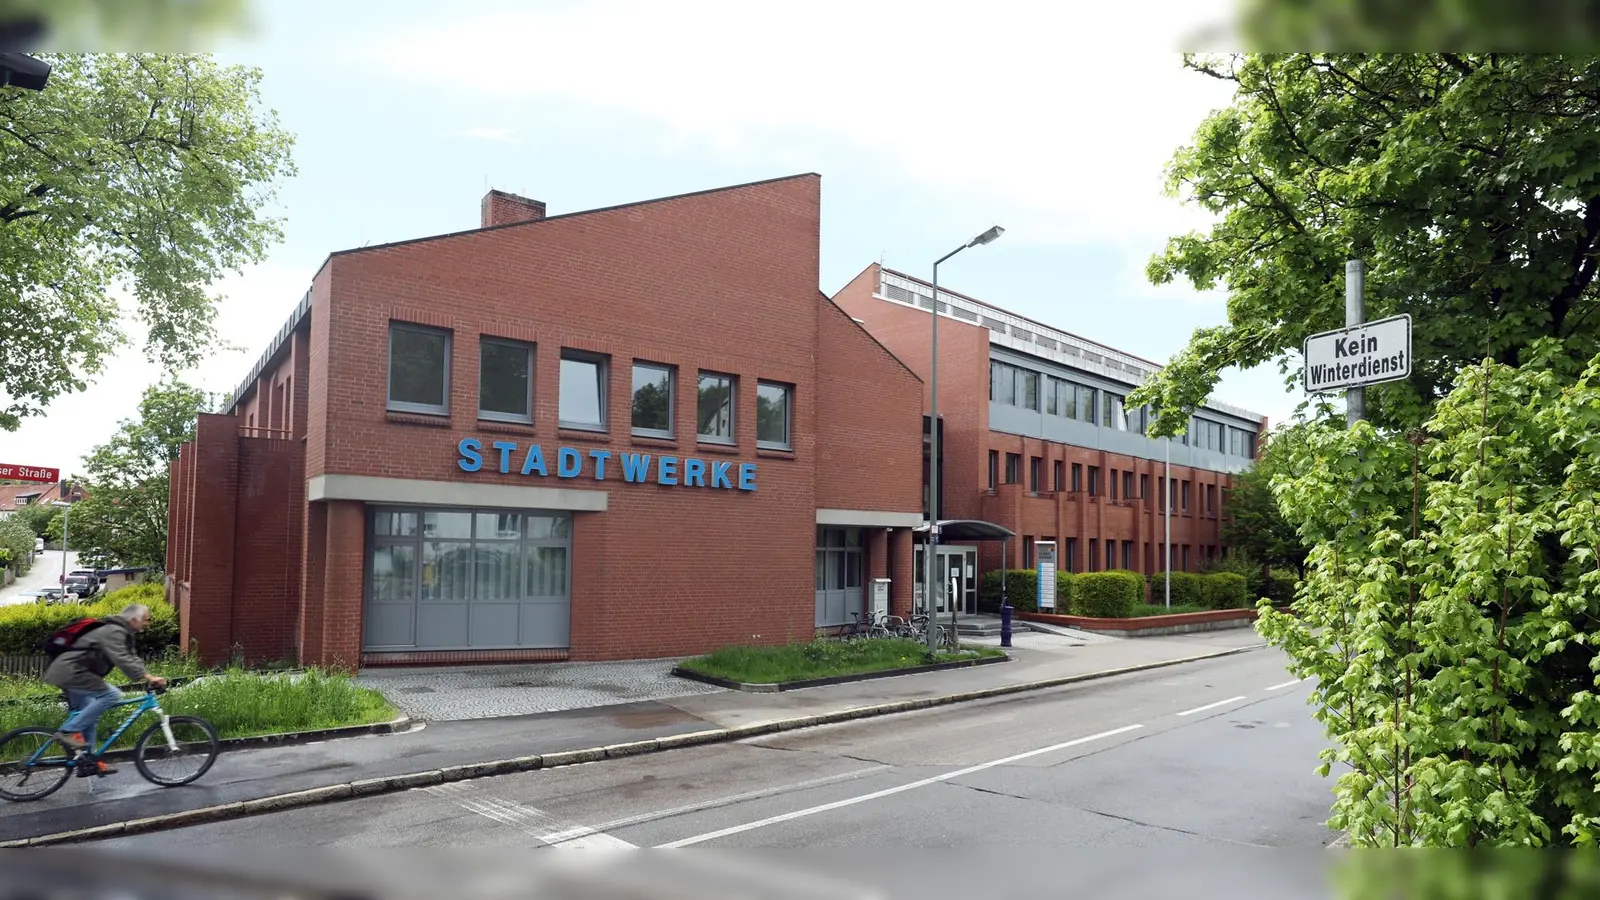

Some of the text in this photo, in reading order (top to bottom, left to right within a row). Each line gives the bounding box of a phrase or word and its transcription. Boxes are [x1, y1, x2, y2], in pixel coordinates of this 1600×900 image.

[1335, 334, 1378, 358] Kein
[1311, 350, 1404, 385] Winterdienst
[19, 467, 52, 478] Straße
[457, 438, 757, 491] STADTWERKE
